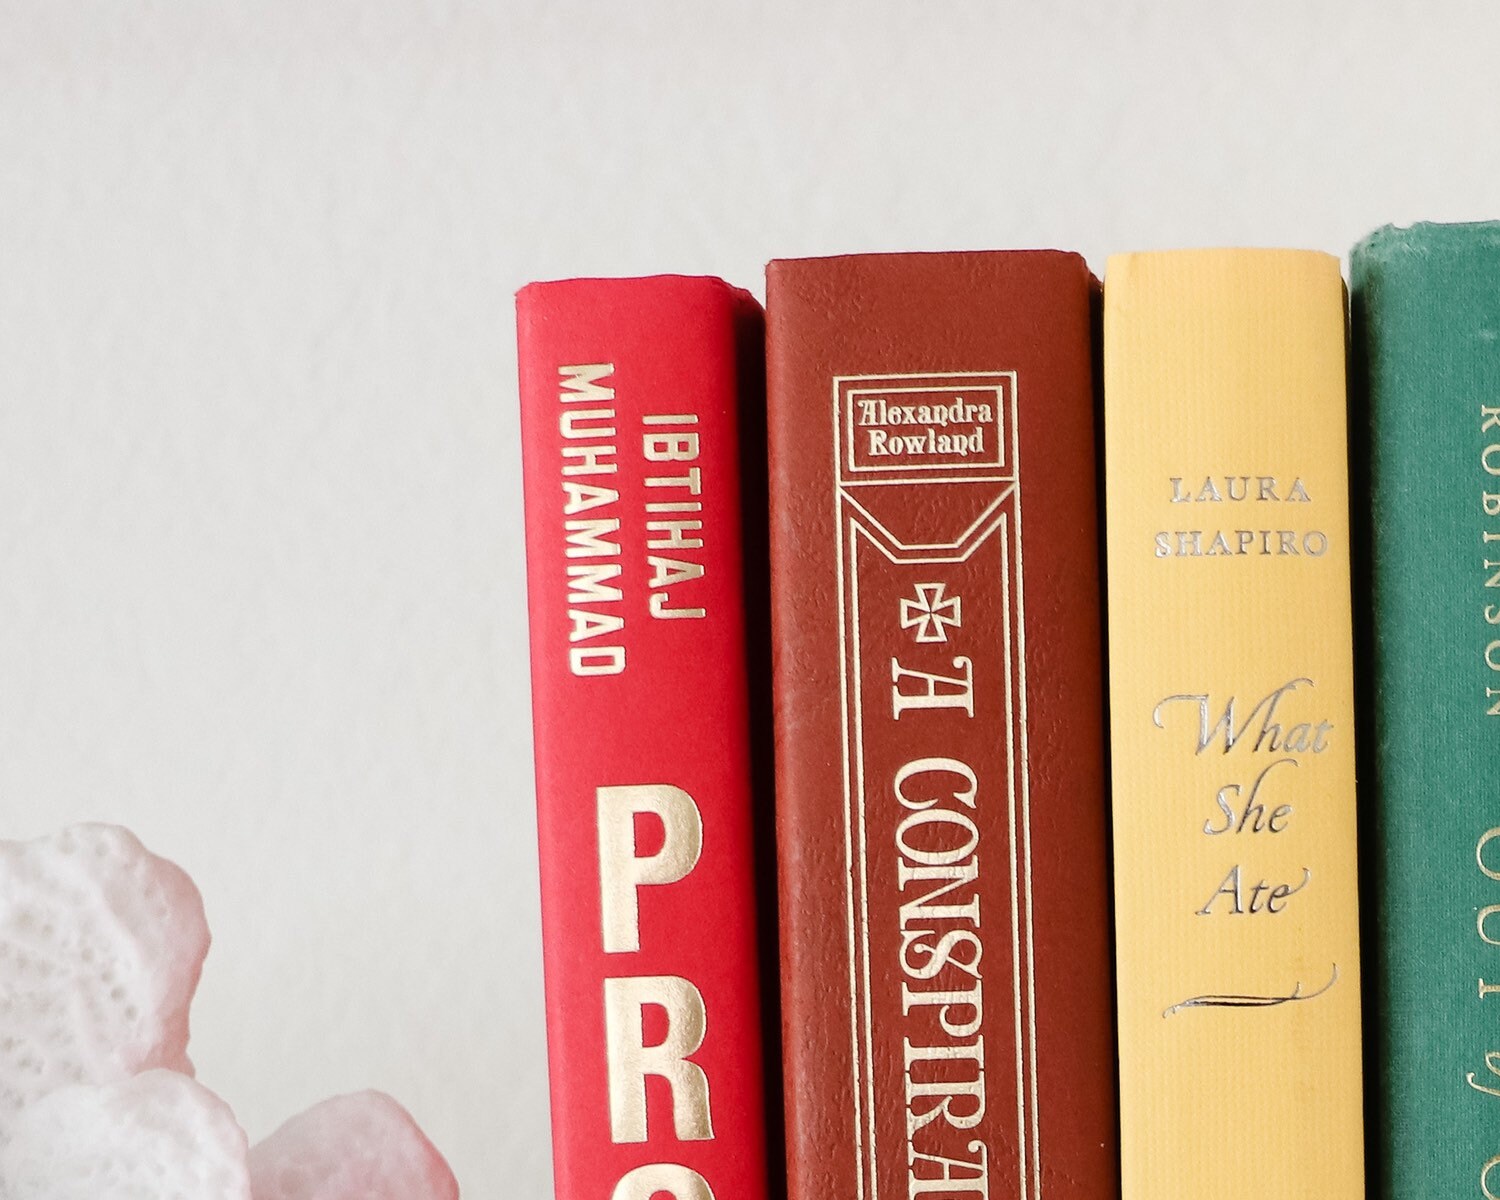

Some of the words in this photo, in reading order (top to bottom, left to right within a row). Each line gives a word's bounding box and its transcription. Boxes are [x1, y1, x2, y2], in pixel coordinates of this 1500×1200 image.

[857, 397, 993, 427] Alexandra
[868, 428, 985, 457] Rowland
[642, 414, 707, 621] IBTIHAJ
[1169, 476, 1311, 503] LAURA
[557, 363, 626, 678] MUHAMMAD
[1153, 530, 1329, 559] SHAPIRO
[890, 656, 974, 721] A
[1152, 677, 1335, 756] What
[1203, 758, 1298, 837] She
[1194, 863, 1311, 916] Ate
